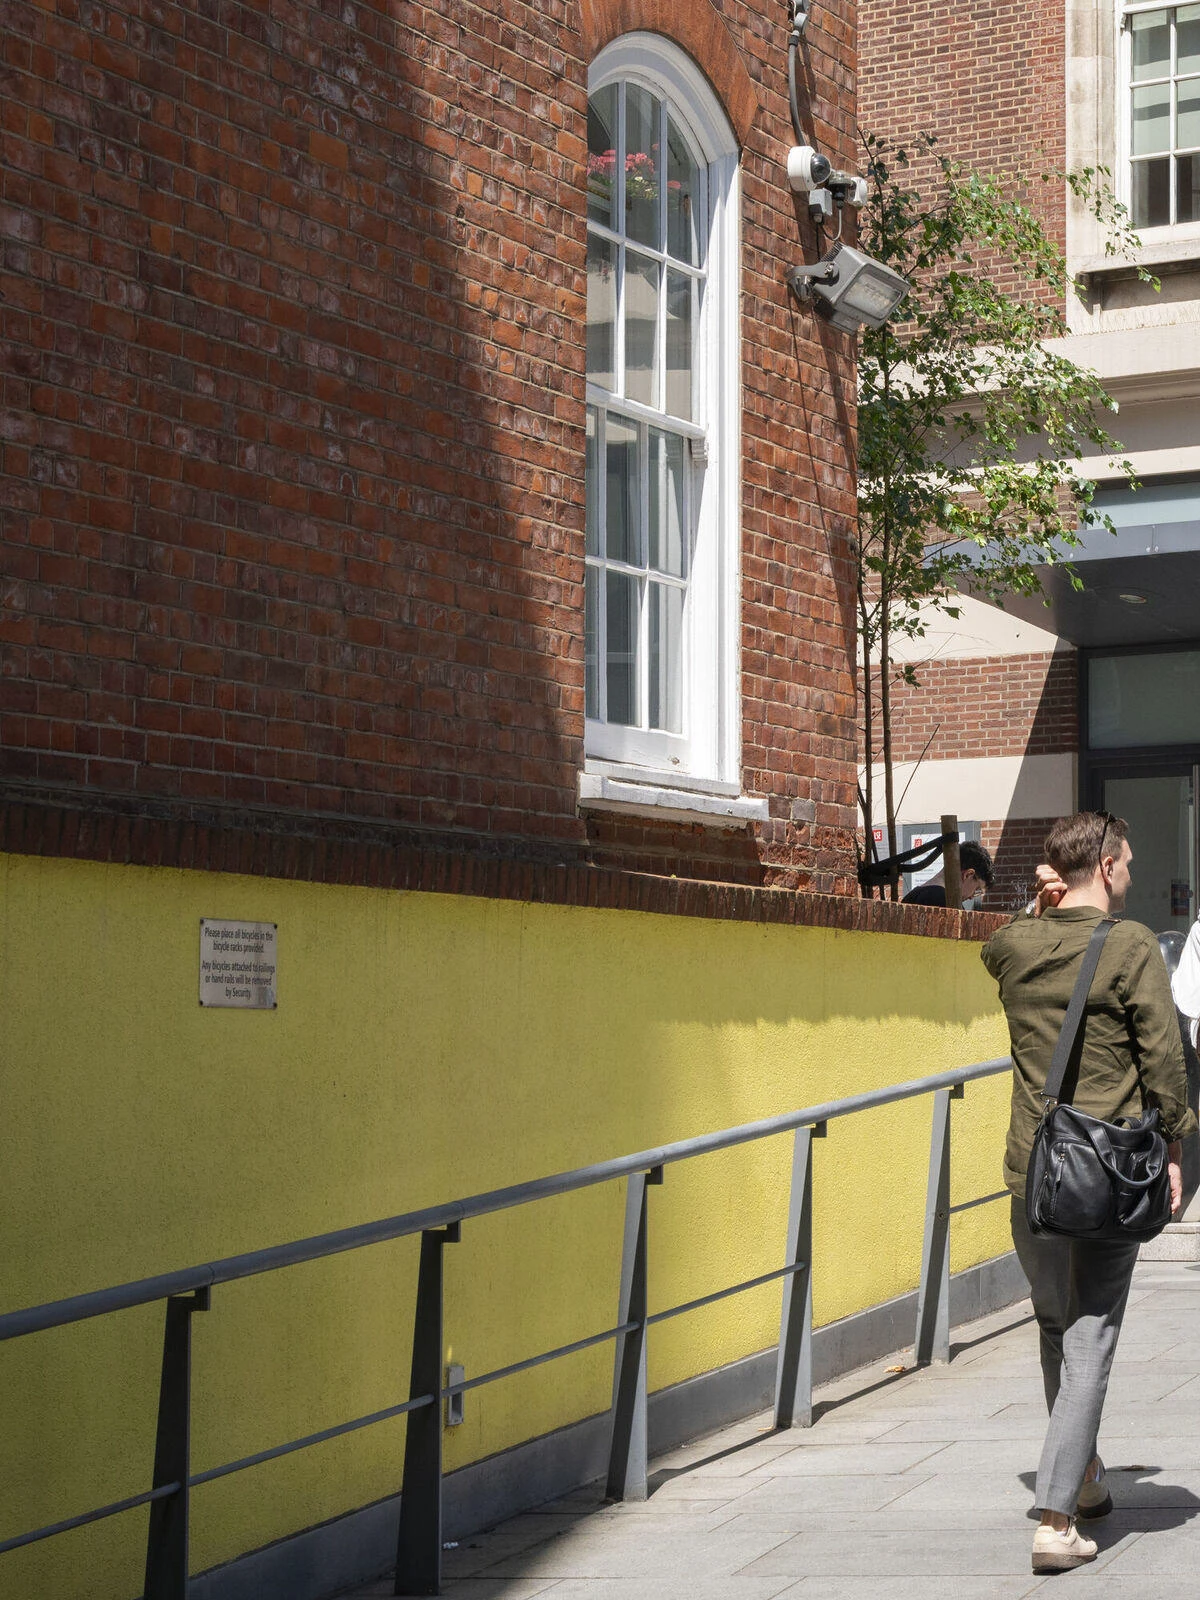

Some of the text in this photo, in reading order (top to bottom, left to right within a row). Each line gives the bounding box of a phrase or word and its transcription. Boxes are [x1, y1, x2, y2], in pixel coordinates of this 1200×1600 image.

[205, 927, 220, 937] Please
[221, 928, 234, 939] place
[242, 930, 259, 942] bicycles
[260, 931, 265, 940] in
[213, 941, 229, 953] bicycle
[231, 942, 242, 951] racks
[202, 960, 275, 975] Any bicycles attached to railings
[212, 974, 223, 983] hand
[225, 973, 234, 984] rails
[236, 975, 244, 984] will
[245, 975, 251, 984] be
[252, 976, 271, 985] removed
[226, 987, 251, 1000] by Security
